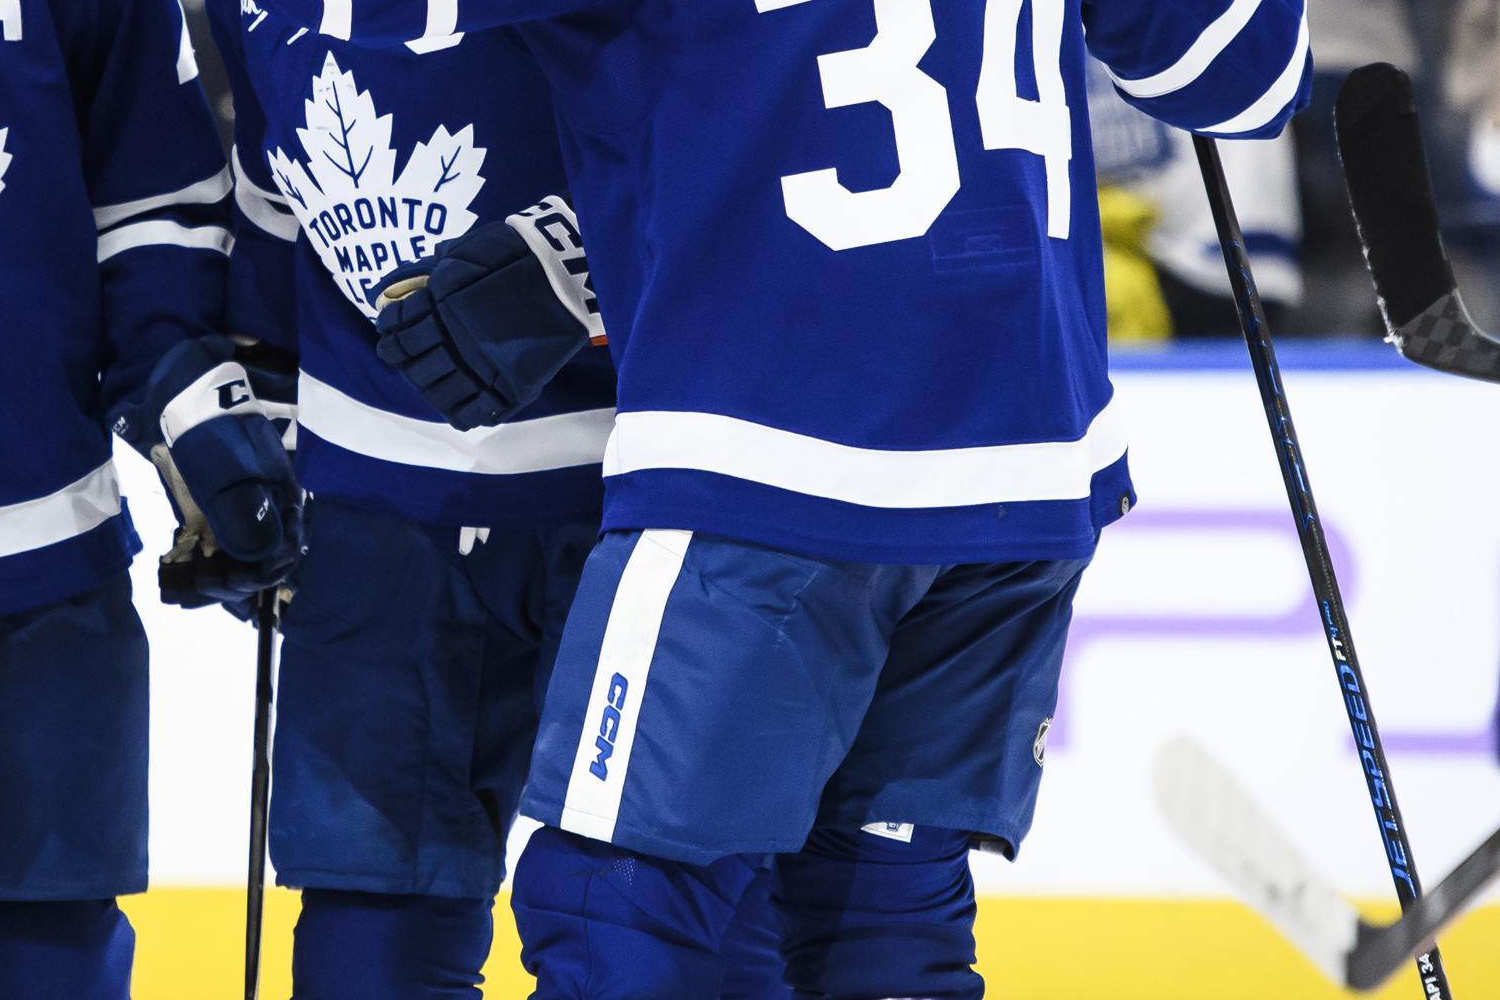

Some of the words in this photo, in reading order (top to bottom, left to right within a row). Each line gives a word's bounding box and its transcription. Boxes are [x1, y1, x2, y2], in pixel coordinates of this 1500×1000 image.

[309, 196, 448, 248] TORONTO
[333, 235, 426, 273] MAPLE
[589, 671, 628, 782] CCM
